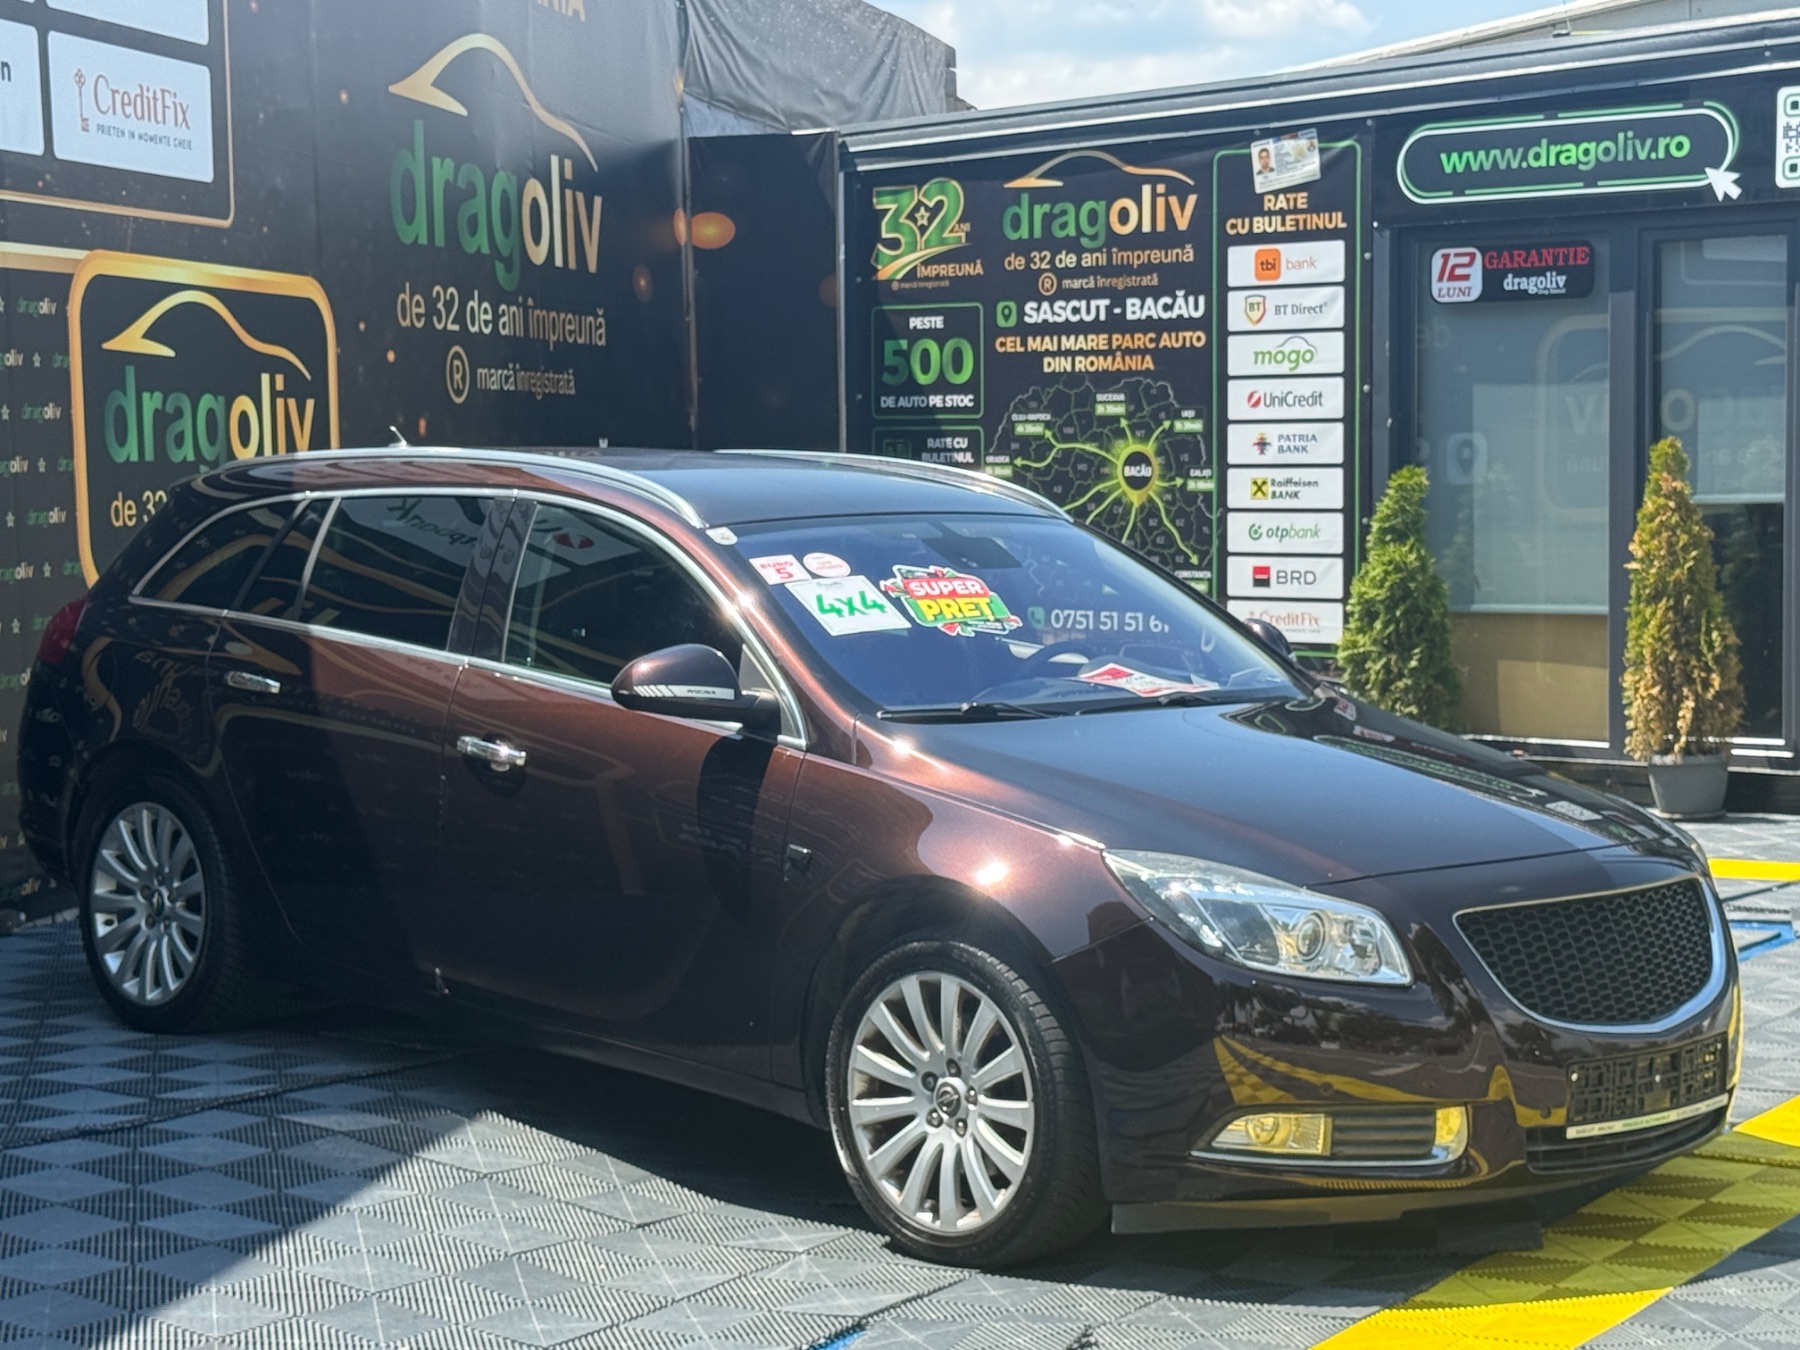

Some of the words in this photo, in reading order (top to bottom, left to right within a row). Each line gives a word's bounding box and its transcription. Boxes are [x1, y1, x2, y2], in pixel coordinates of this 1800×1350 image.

[93, 74, 191, 130] CreditFix
[96, 123, 126, 140] PRIETEN
[127, 130, 136, 141] IN
[1440, 131, 1691, 175] www.dragoliv.ro
[389, 119, 603, 292] dragoliv
[1263, 192, 1308, 212] RATE
[1002, 183, 1198, 249] dragoliv
[1225, 218, 1250, 235] CU
[1252, 211, 1347, 234] BULETINUL
[1004, 252, 1026, 271] de
[1030, 251, 1051, 270] 32
[1055, 249, 1077, 269] de
[1081, 248, 1107, 267] ani
[1111, 244, 1195, 270] împreună
[1260, 257, 1277, 272] tbi
[1285, 256, 1317, 271] bank
[1437, 252, 1476, 283] 12
[1483, 246, 1590, 270] GARANTIE
[916, 259, 984, 279] ÎMPREUNĂ
[1062, 274, 1095, 290] marcă
[1096, 273, 1159, 292] înregistrată
[1437, 286, 1473, 299] LUNI
[1503, 271, 1567, 296] dragoliv
[16, 297, 57, 318] dragoliv
[397, 282, 425, 328] de
[432, 285, 460, 332] 32
[466, 290, 493, 335] de
[498, 295, 524, 338] ani
[528, 298, 607, 351] împreună
[1023, 299, 1111, 325] SASCUT
[1126, 290, 1206, 322] BACĂU
[1248, 301, 1261, 313] BT
[1274, 304, 1289, 316] BT
[909, 316, 945, 330] PESTE
[995, 336, 1024, 354] CEL
[1027, 335, 1058, 353] MAI
[1060, 334, 1109, 352] MARE
[1111, 333, 1157, 350] PARC
[1158, 331, 1206, 349] AUTO
[881, 337, 975, 386] 500
[1043, 356, 1072, 374] DIN
[1074, 354, 1155, 373] ROMÂNIA
[1254, 347, 1315, 371] mogo
[477, 362, 515, 392] marcă
[880, 395, 896, 408] DE
[897, 395, 928, 408] AUTO
[929, 394, 944, 408] PE
[945, 393, 974, 408] STOC
[1263, 390, 1324, 408] UniCredit
[22, 402, 62, 424] dragoliv
[104, 365, 315, 474] dragoliv
[927, 437, 952, 449] RATE
[953, 436, 968, 449] CU
[1277, 434, 1318, 444] PATRIA
[921, 451, 975, 464] BULETINUL
[1277, 444, 1309, 455] BANK
[1123, 463, 1153, 478] BACĂU
[1270, 478, 1319, 489] Raiffeisen
[1270, 490, 1300, 501] BANK
[110, 491, 137, 527] de
[1266, 525, 1320, 543] otpbank
[774, 566, 795, 580] 5
[1276, 570, 1317, 586] BRD
[908, 580, 985, 597] SUPER
[1051, 608, 1094, 630] 0751
[1099, 611, 1119, 631] 51
[1123, 612, 1144, 632] 51
[1149, 615, 1170, 634] 6
